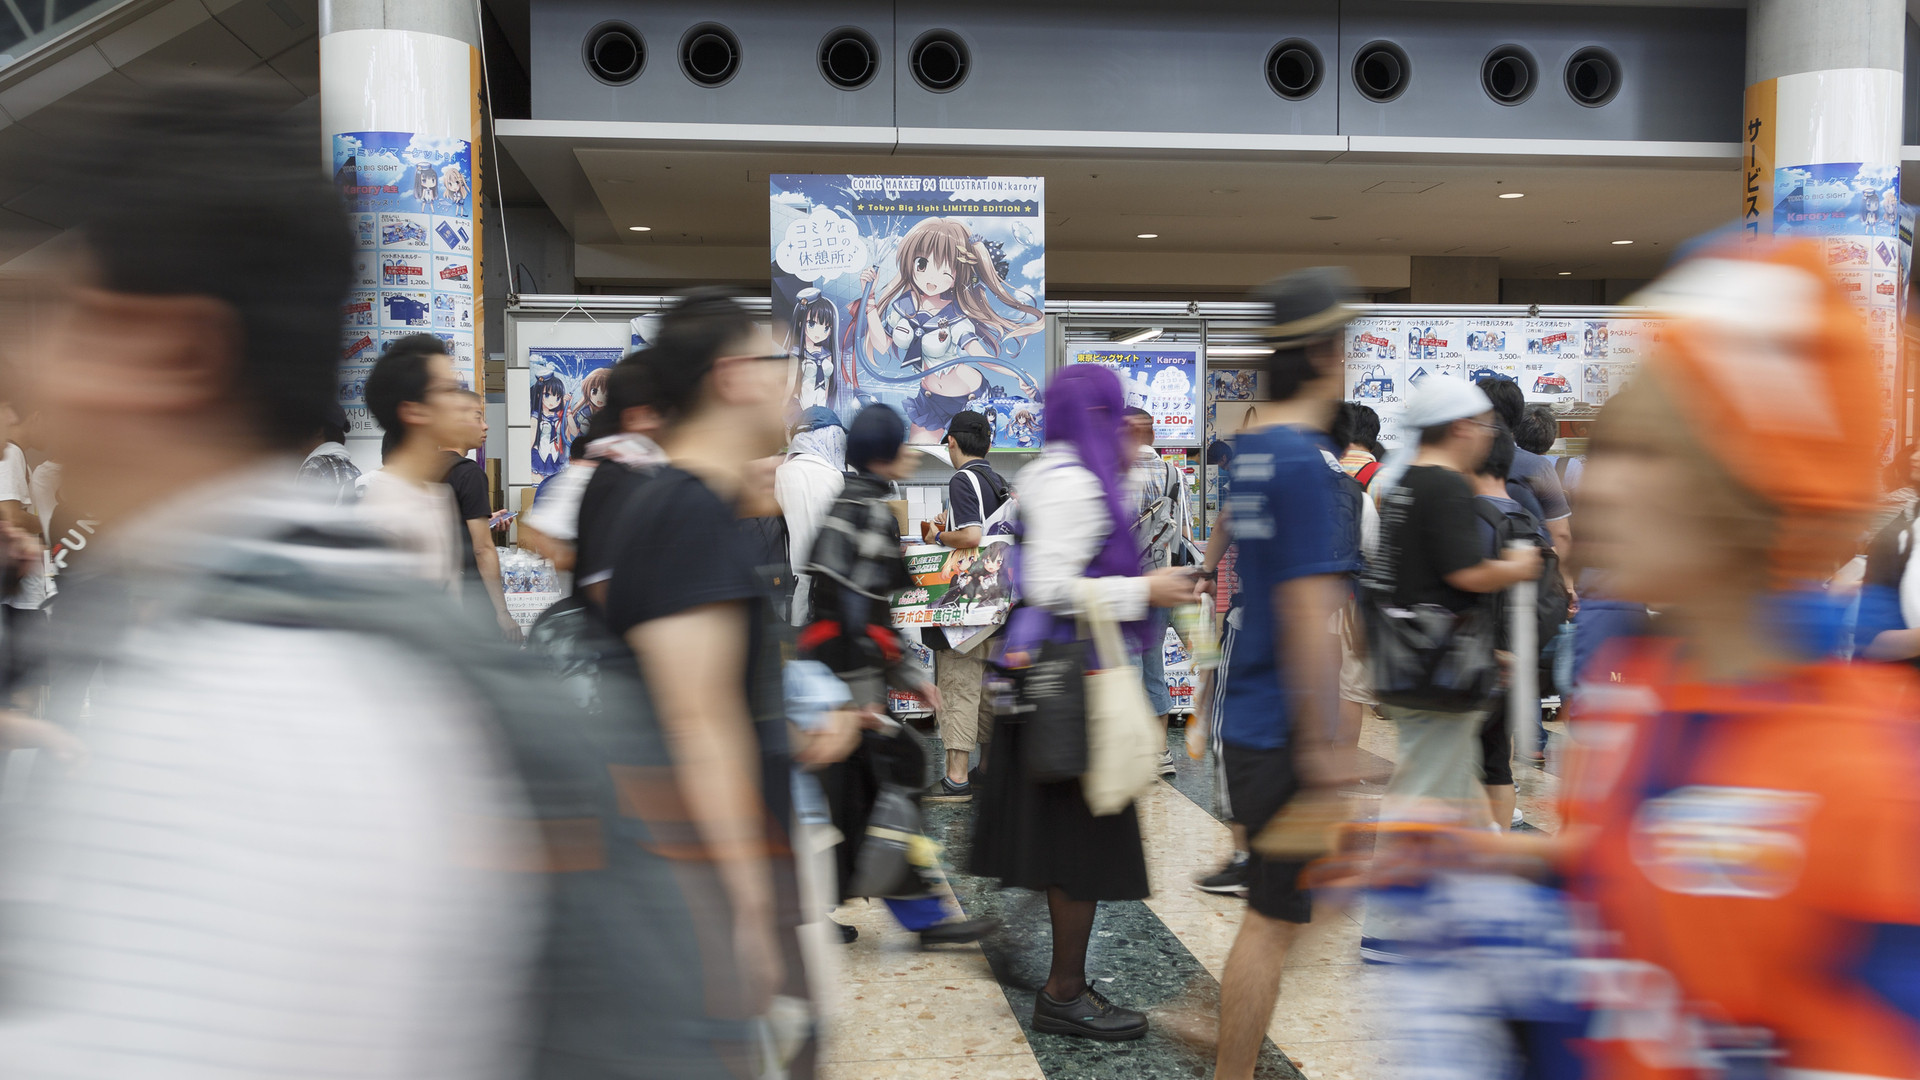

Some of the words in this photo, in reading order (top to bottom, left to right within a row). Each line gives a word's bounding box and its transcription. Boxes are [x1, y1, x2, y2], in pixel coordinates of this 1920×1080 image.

[377, 164, 398, 172] SIGHT
[343, 185, 382, 195] Karory
[852, 178, 882, 190] COMIC
[885, 179, 921, 191] MARKET
[923, 179, 936, 191] 94
[941, 180, 1038, 194] ILLUSTRATION:karory
[868, 204, 895, 212] Tokyo
[899, 204, 913, 212] Big
[1787, 212, 1829, 222] Karory
[796, 220, 846, 234] コミケは
[798, 237, 851, 249] ココロの
[1077, 353, 1140, 363] 東京ビッグサイト
[1156, 356, 1187, 365] Karory
[346, 408, 376, 420] 사이
[1165, 415, 1193, 425] 200円
